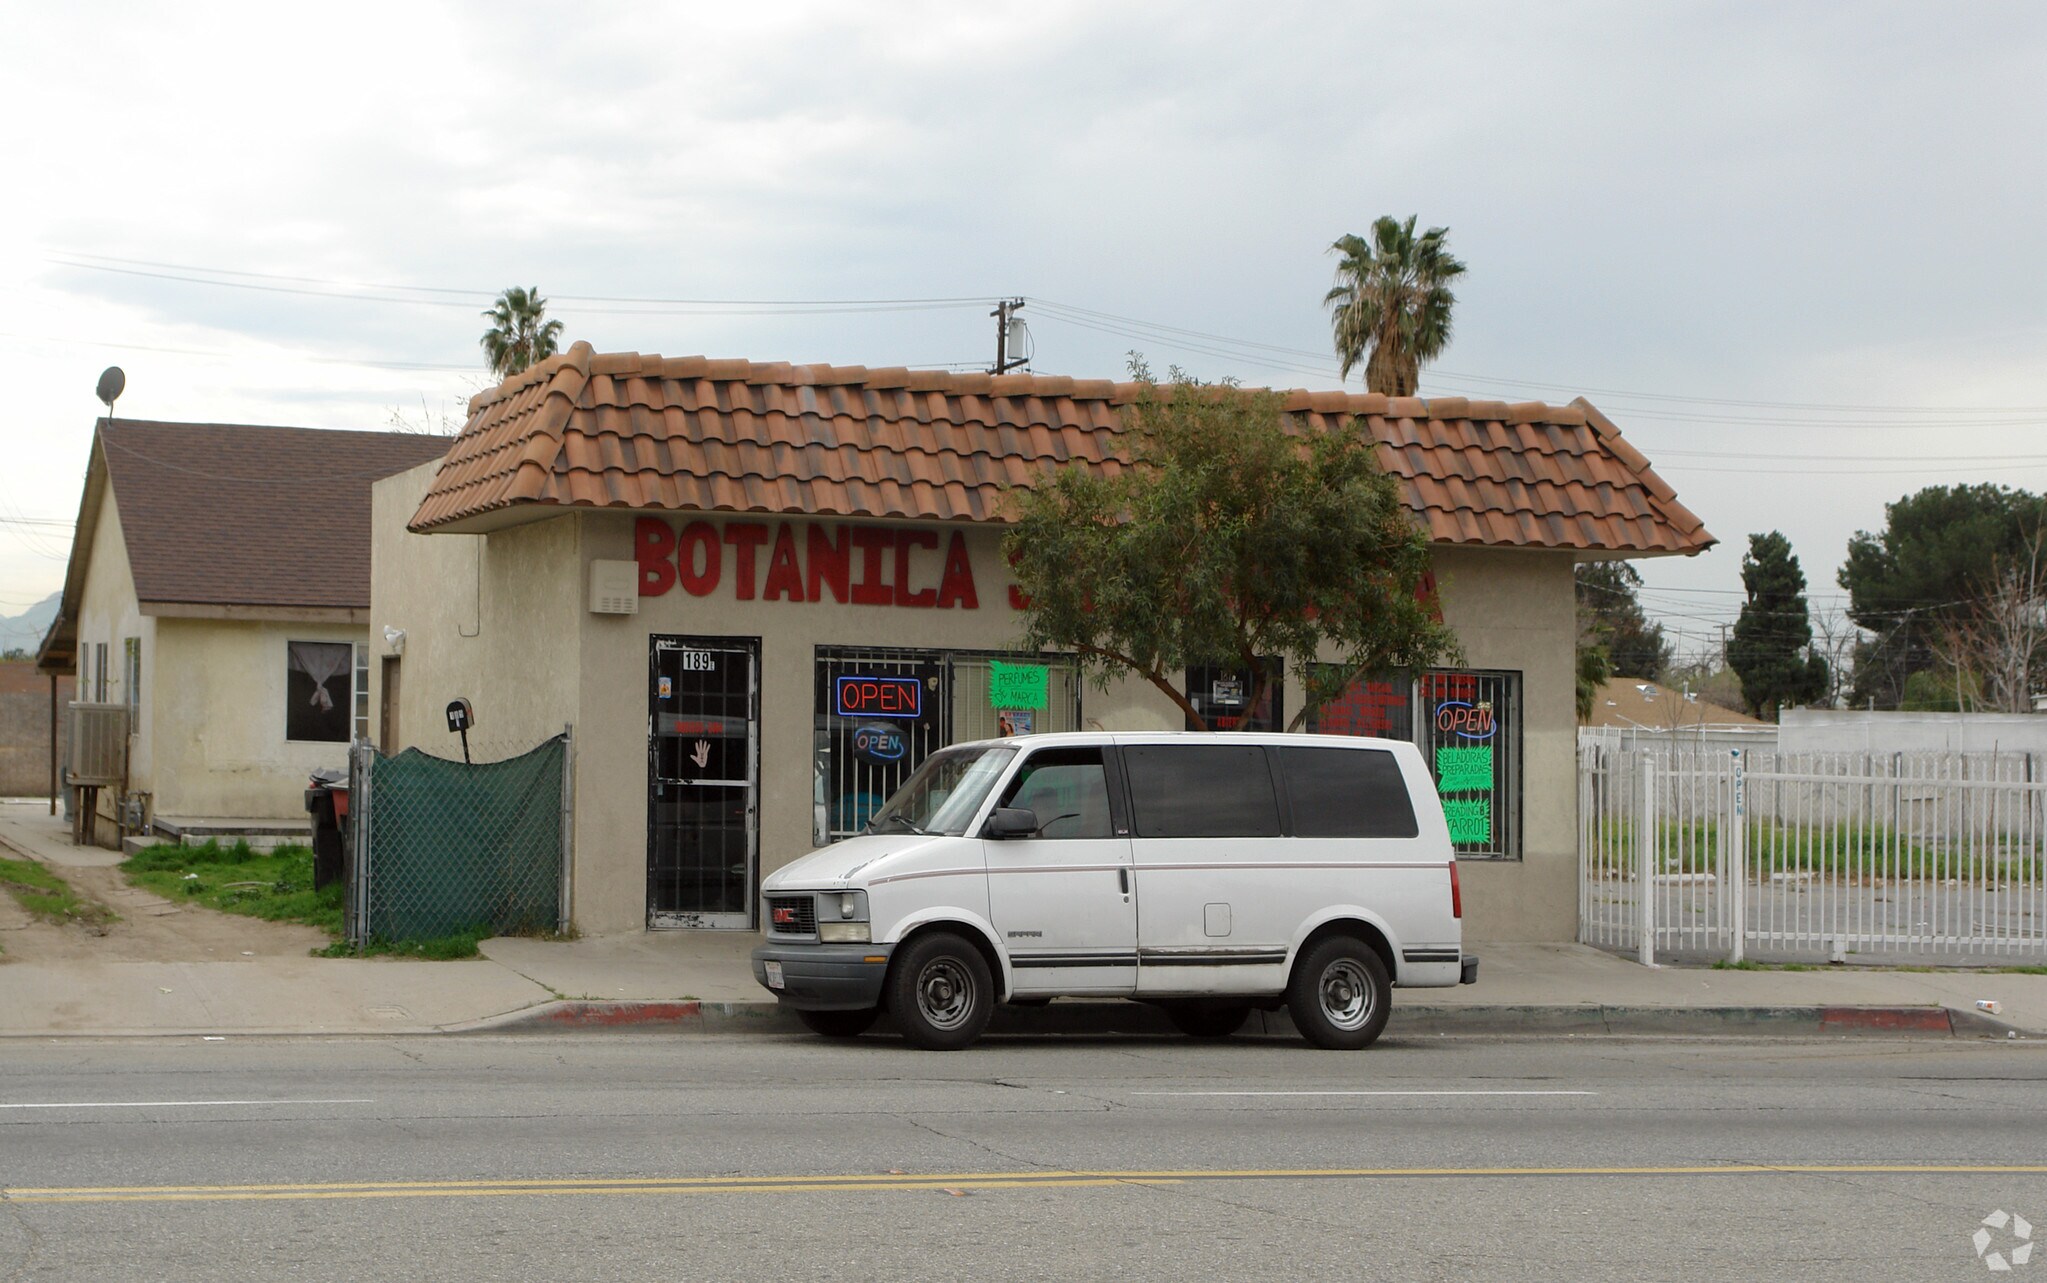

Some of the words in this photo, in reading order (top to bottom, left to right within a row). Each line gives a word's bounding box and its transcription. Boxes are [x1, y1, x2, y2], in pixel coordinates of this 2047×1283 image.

[635, 516, 979, 609] BOTANICA
[998, 670, 1040, 687] PERFUMES
[843, 683, 916, 711] OPEN
[1010, 690, 1039, 705] MARCA
[1438, 708, 1492, 731] OPEN
[857, 735, 900, 749] OPEN
[1443, 751, 1489, 764] BELADORAS
[1735, 767, 1743, 816] OPEN
[1445, 805, 1479, 817] READING
